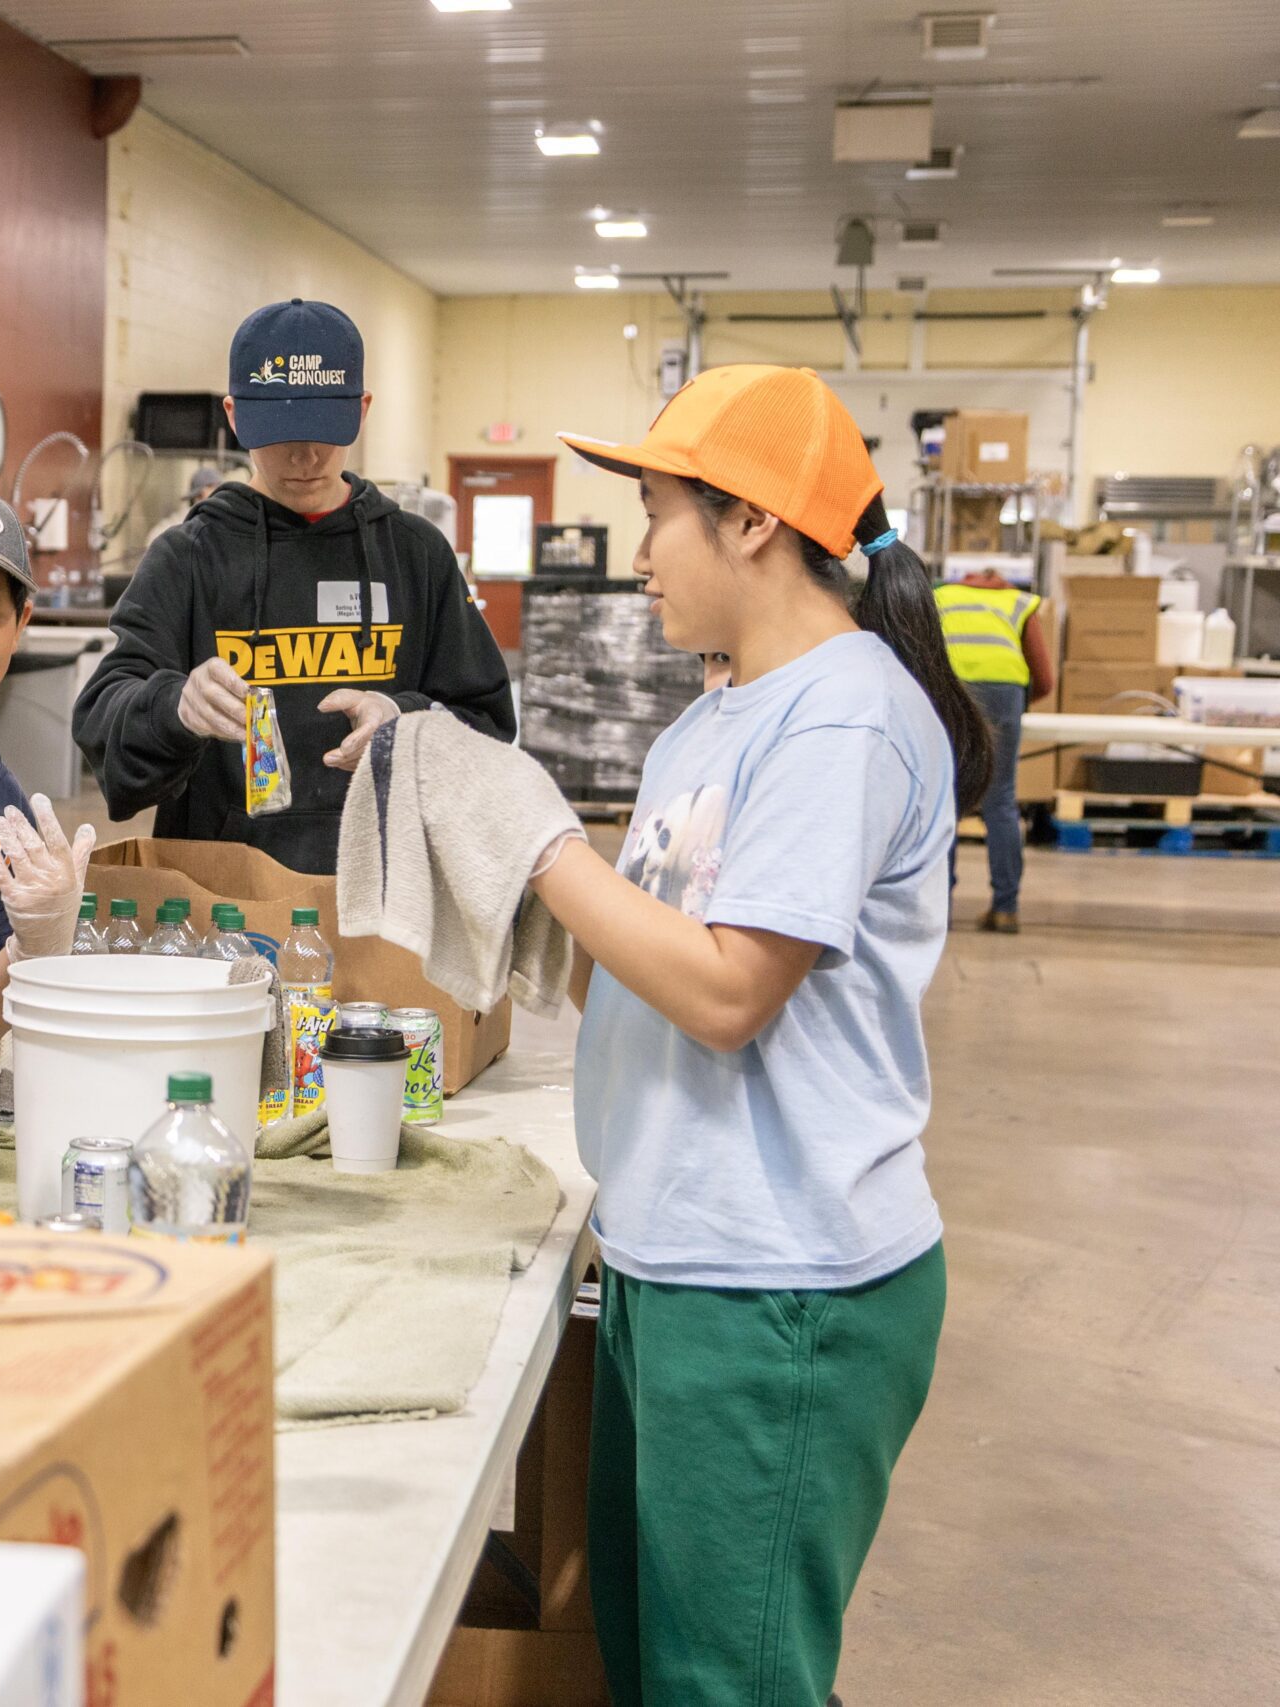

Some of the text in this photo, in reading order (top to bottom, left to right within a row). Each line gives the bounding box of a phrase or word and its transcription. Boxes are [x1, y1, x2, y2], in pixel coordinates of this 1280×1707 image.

[288, 354, 323, 371] CAMP
[287, 370, 346, 387] CONQUEST
[410, 1036, 437, 1074] La
[404, 1074, 441, 1100] roix
